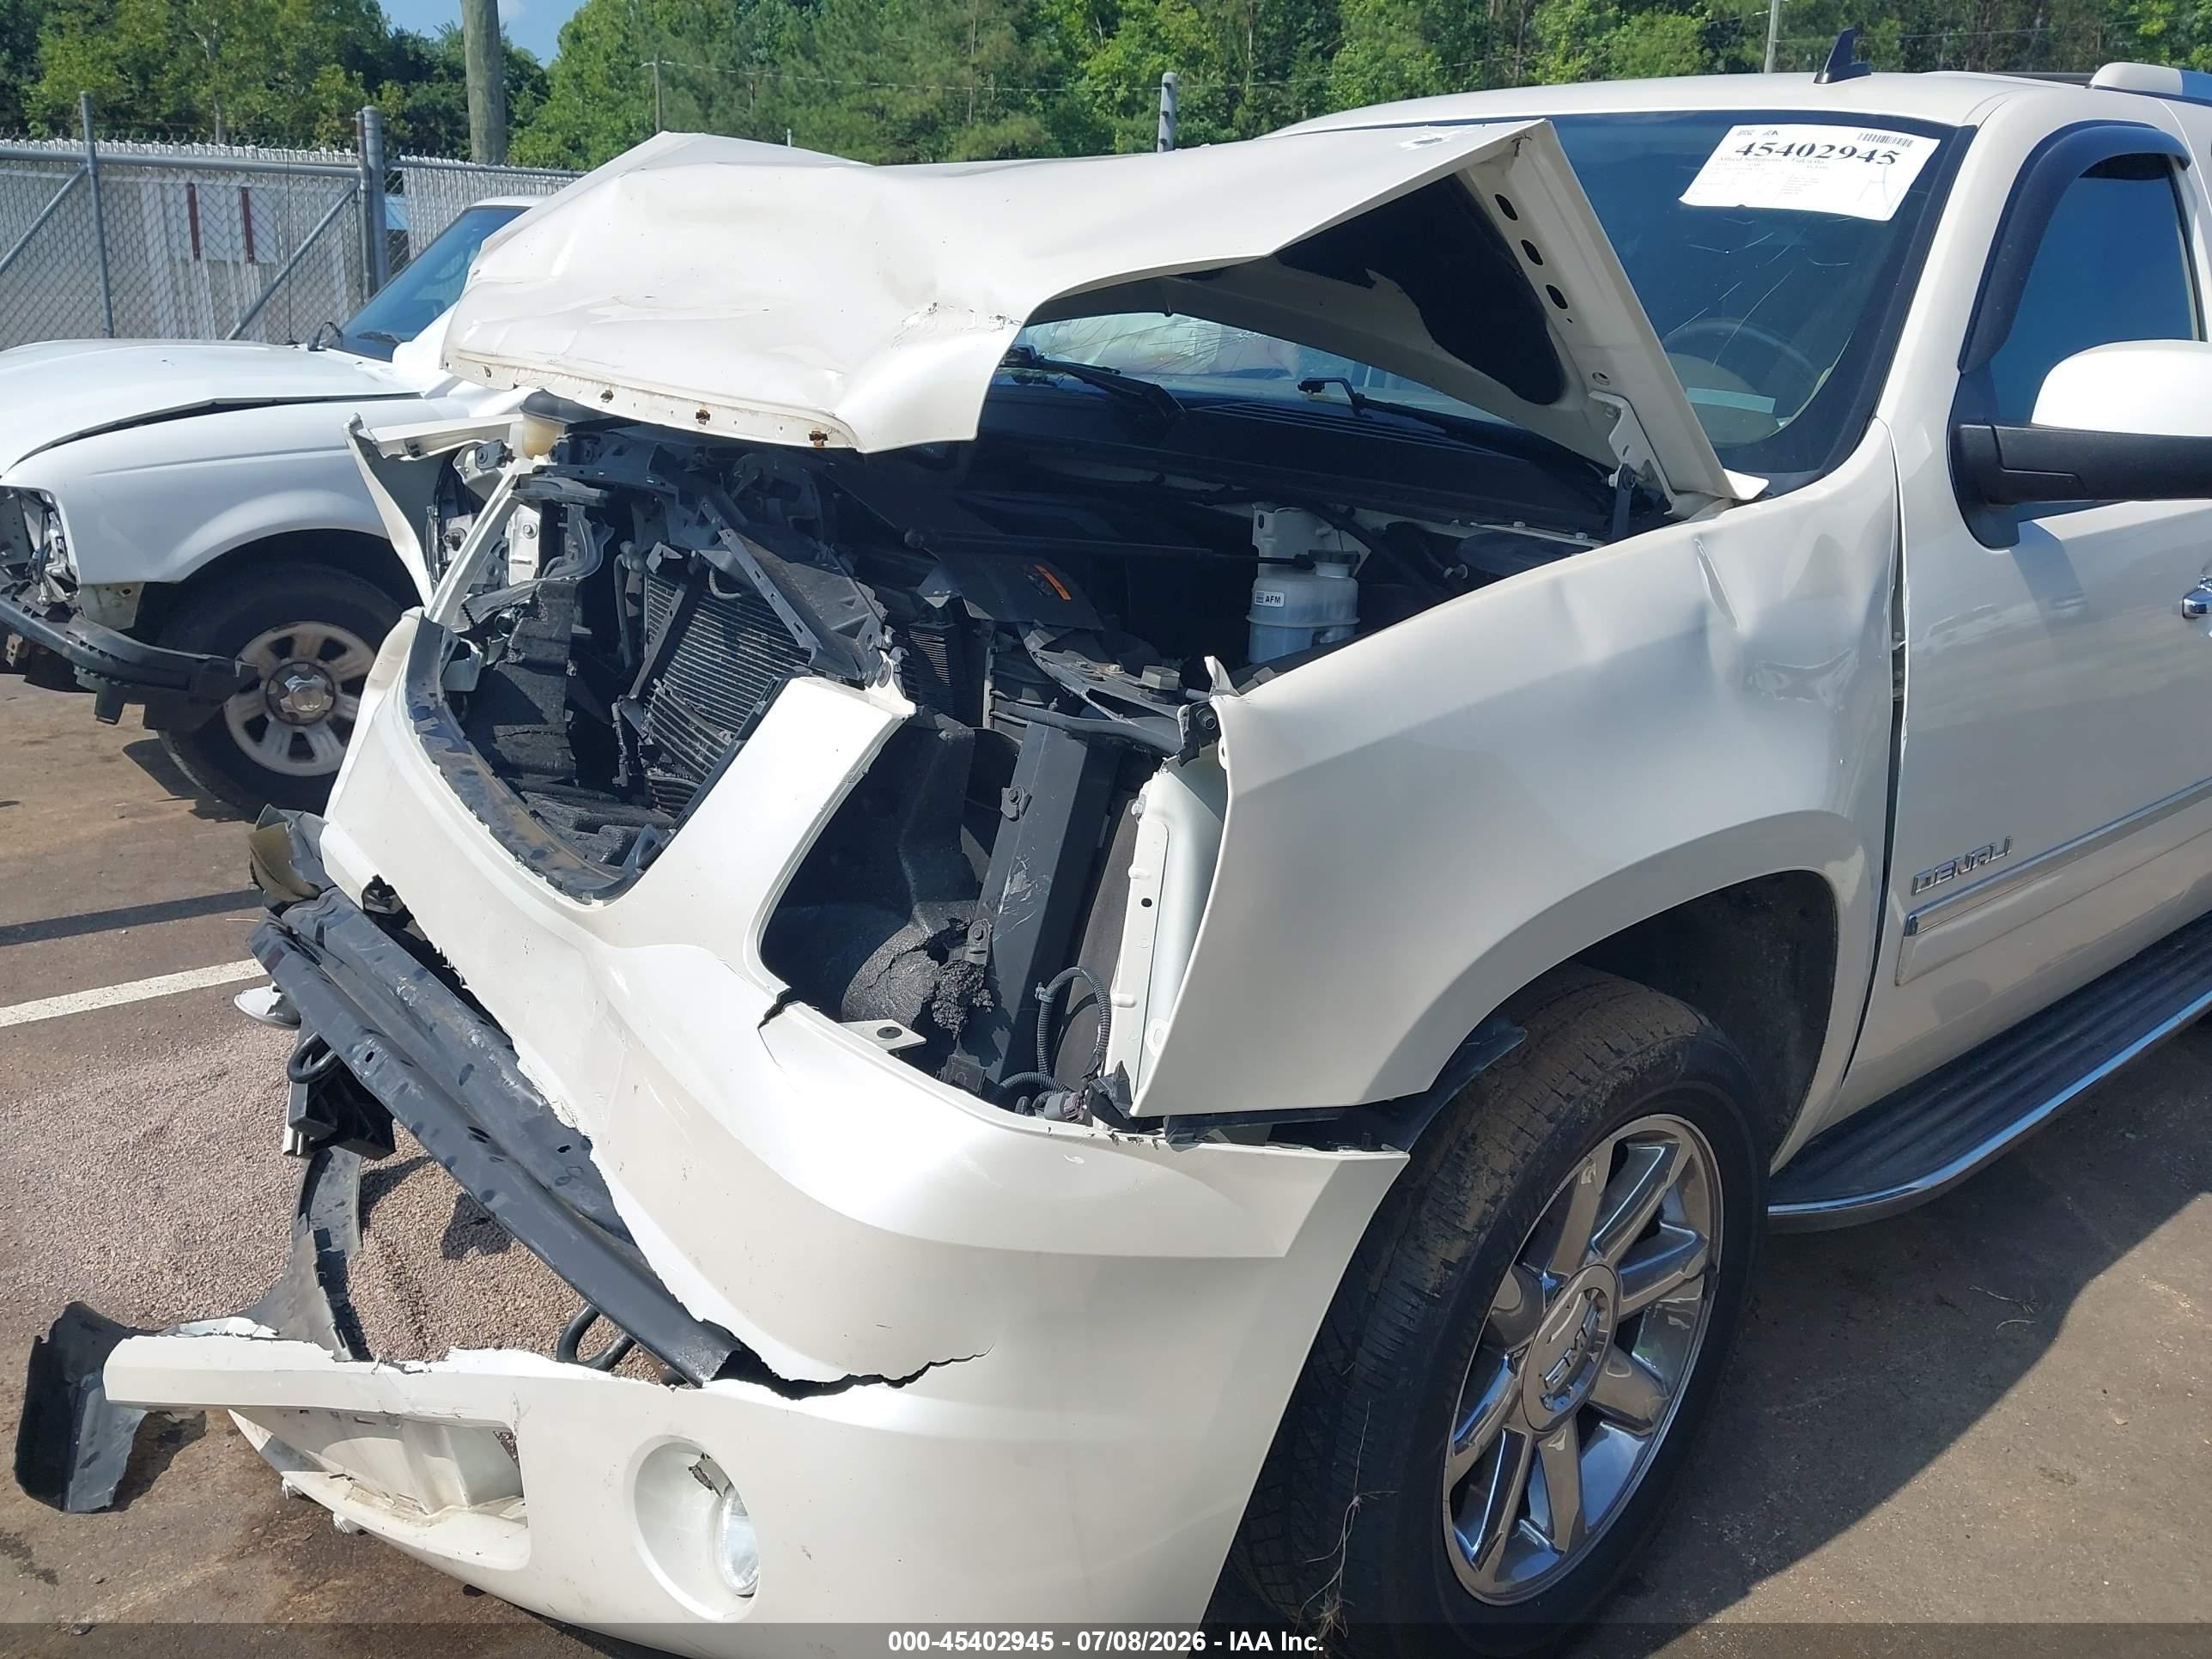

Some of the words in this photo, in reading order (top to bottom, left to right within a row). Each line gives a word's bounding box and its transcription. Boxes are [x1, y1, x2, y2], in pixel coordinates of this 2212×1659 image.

[1735, 142, 1901, 165] 45402945
[1265, 595, 1281, 605] AFM
[1911, 836, 2013, 896] DENALI
